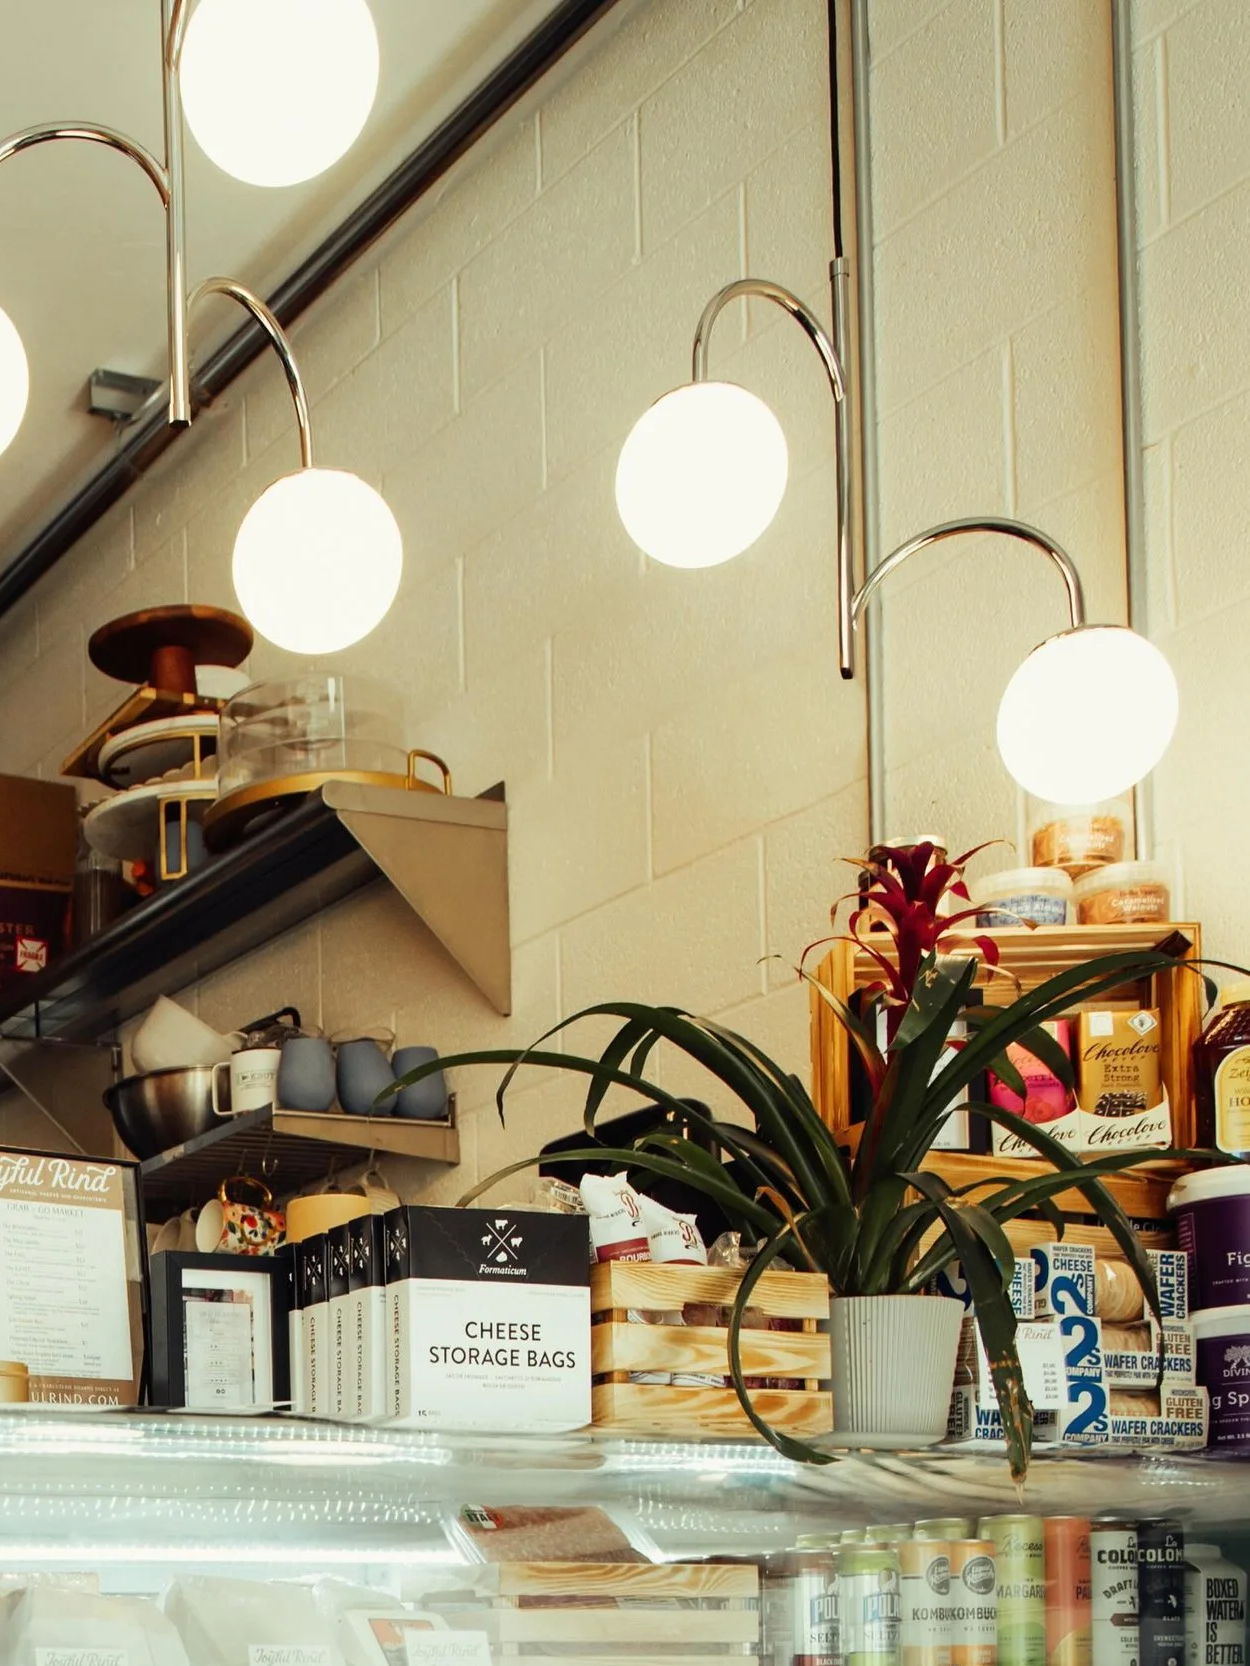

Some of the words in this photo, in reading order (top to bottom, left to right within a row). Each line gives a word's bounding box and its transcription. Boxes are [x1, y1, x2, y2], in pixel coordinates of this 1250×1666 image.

[1082, 1039, 1160, 1062] Chocolove
[1104, 1064, 1139, 1072] Extra
[1103, 1073, 1140, 1082] Strong
[1088, 1118, 1166, 1145] Chocolove
[48, 1158, 116, 1193] Rind
[52, 1207, 85, 1217] MARKET
[479, 1264, 527, 1276] Formaticum
[1053, 1259, 1093, 1272] CHEESE
[1012, 1262, 1022, 1315] CHEESE
[1160, 1253, 1175, 1318] WAFER
[1176, 1254, 1186, 1319] CRACKERS
[1086, 1275, 1094, 1315] COMPANY
[465, 1321, 542, 1341] CHEESE
[429, 1346, 520, 1367] STORAGE
[528, 1350, 576, 1368] BAGS
[1104, 1354, 1137, 1369] WAFER
[1166, 1397, 1203, 1407] GLUTEN
[1166, 1407, 1203, 1419] FREE
[975, 1428, 1004, 1439] CRAC
[1112, 1421, 1147, 1435] WAFER
[1151, 1421, 1203, 1436] CRACKERS
[1065, 1433, 1109, 1442] COMPANY
[1206, 1578, 1239, 1599] BOXED
[1206, 1622, 1217, 1642] IS
